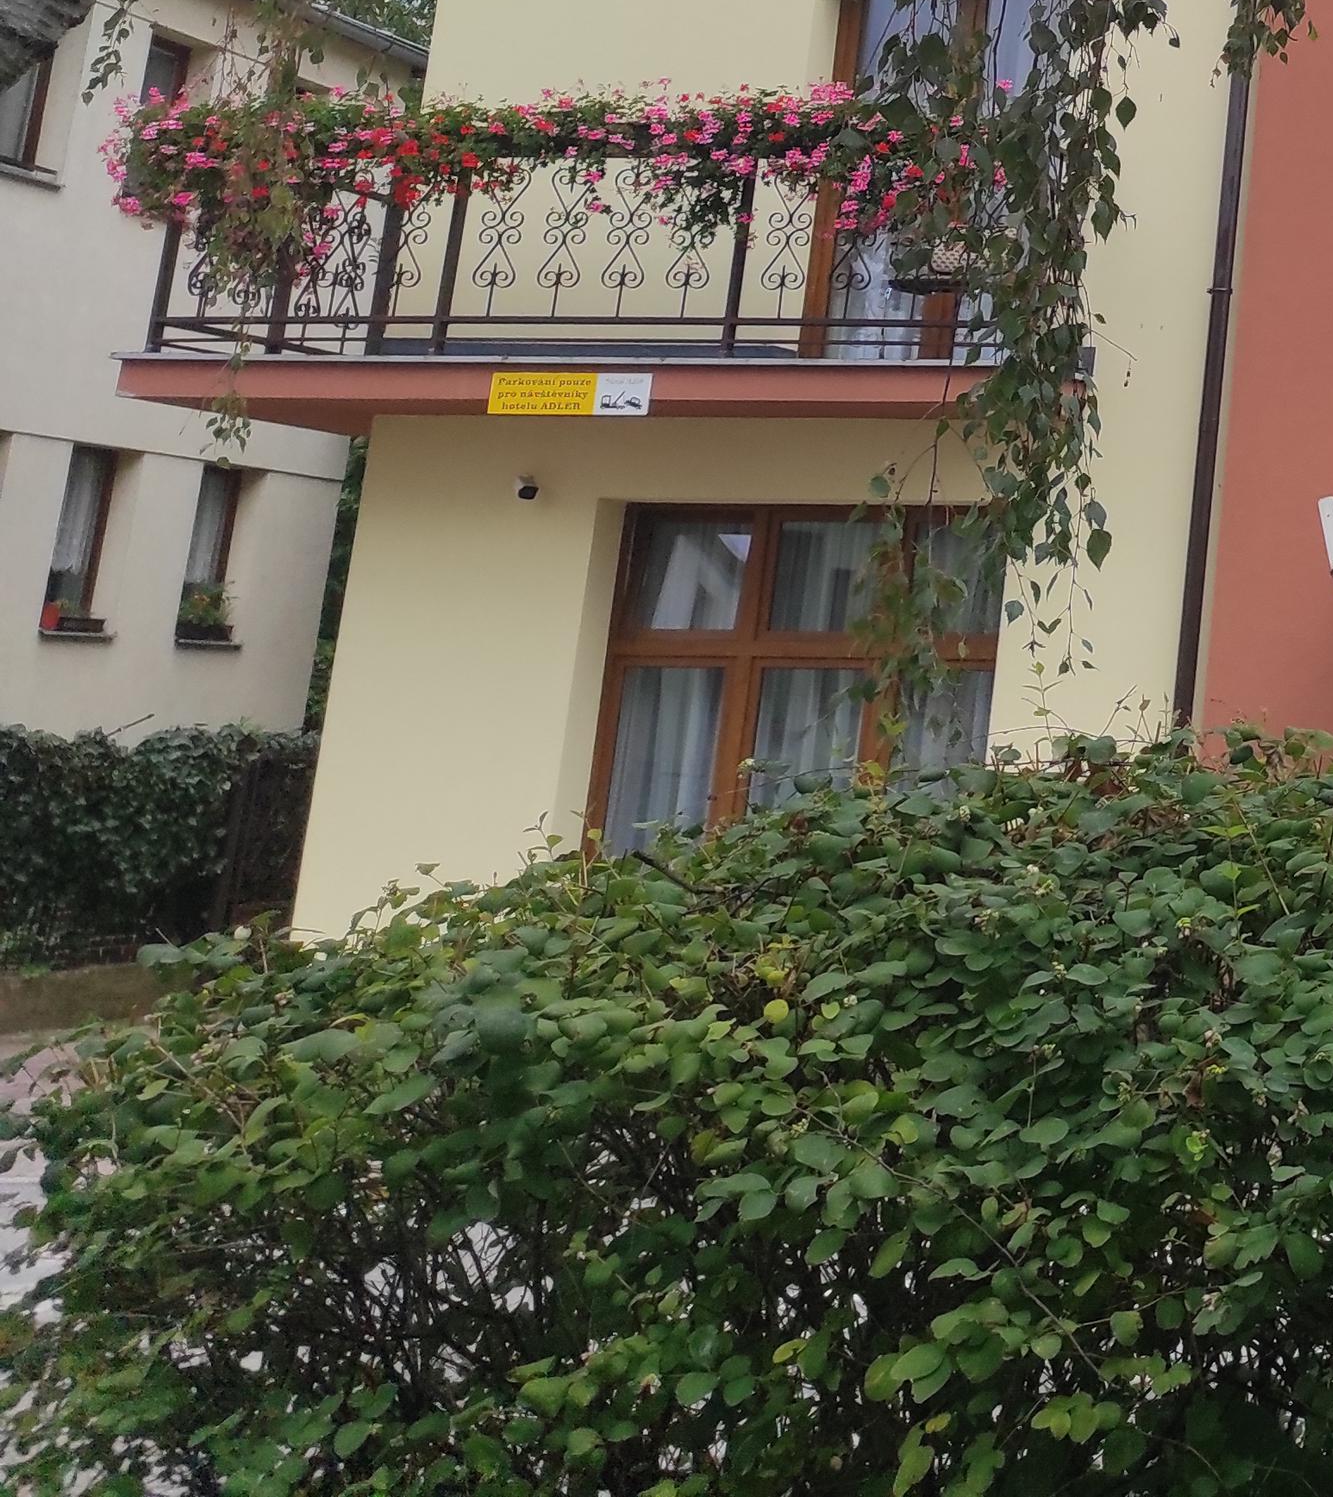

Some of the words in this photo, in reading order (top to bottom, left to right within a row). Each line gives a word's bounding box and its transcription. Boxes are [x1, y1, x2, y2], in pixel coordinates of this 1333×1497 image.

[559, 378, 592, 387] pouze
[497, 390, 516, 399] pro
[502, 402, 536, 410] hotelu
[541, 402, 580, 410] ADLER
